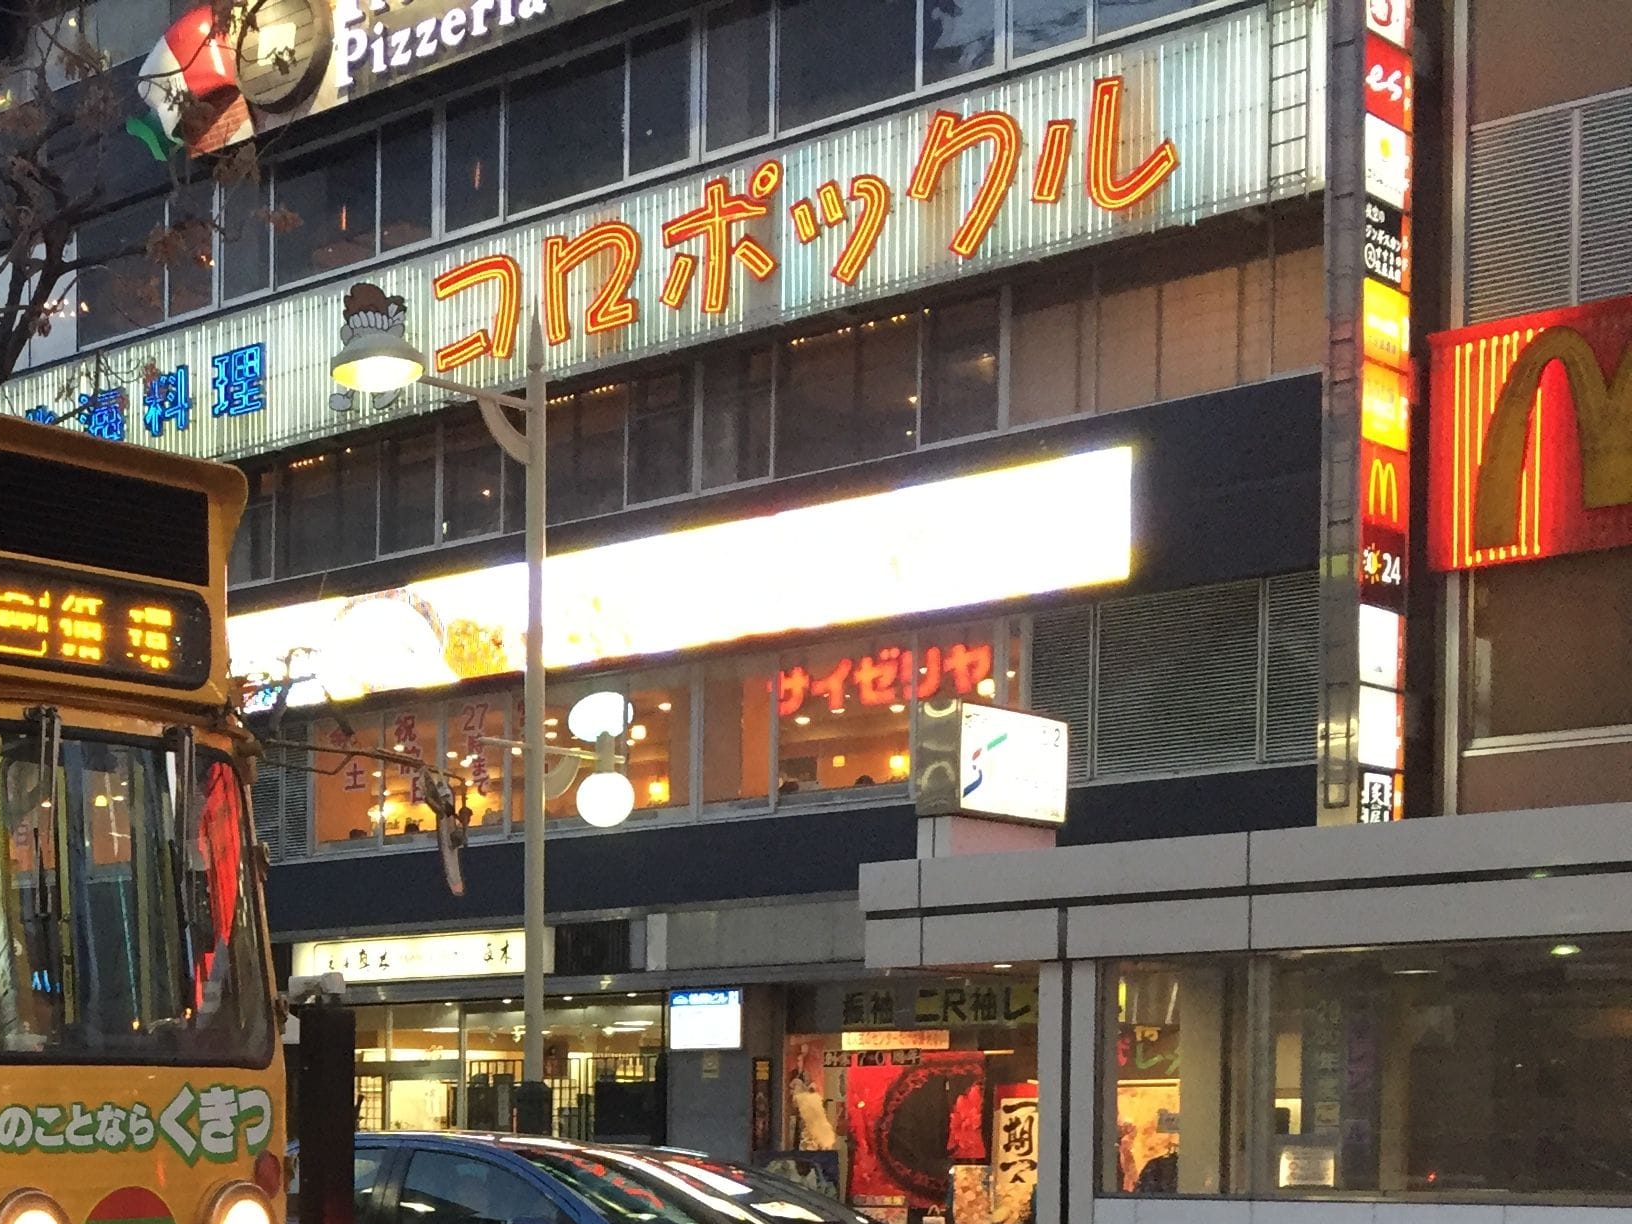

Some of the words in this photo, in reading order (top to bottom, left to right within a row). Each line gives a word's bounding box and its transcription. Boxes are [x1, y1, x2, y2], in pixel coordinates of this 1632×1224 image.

[776, 643, 994, 716] サイゼリヤ
